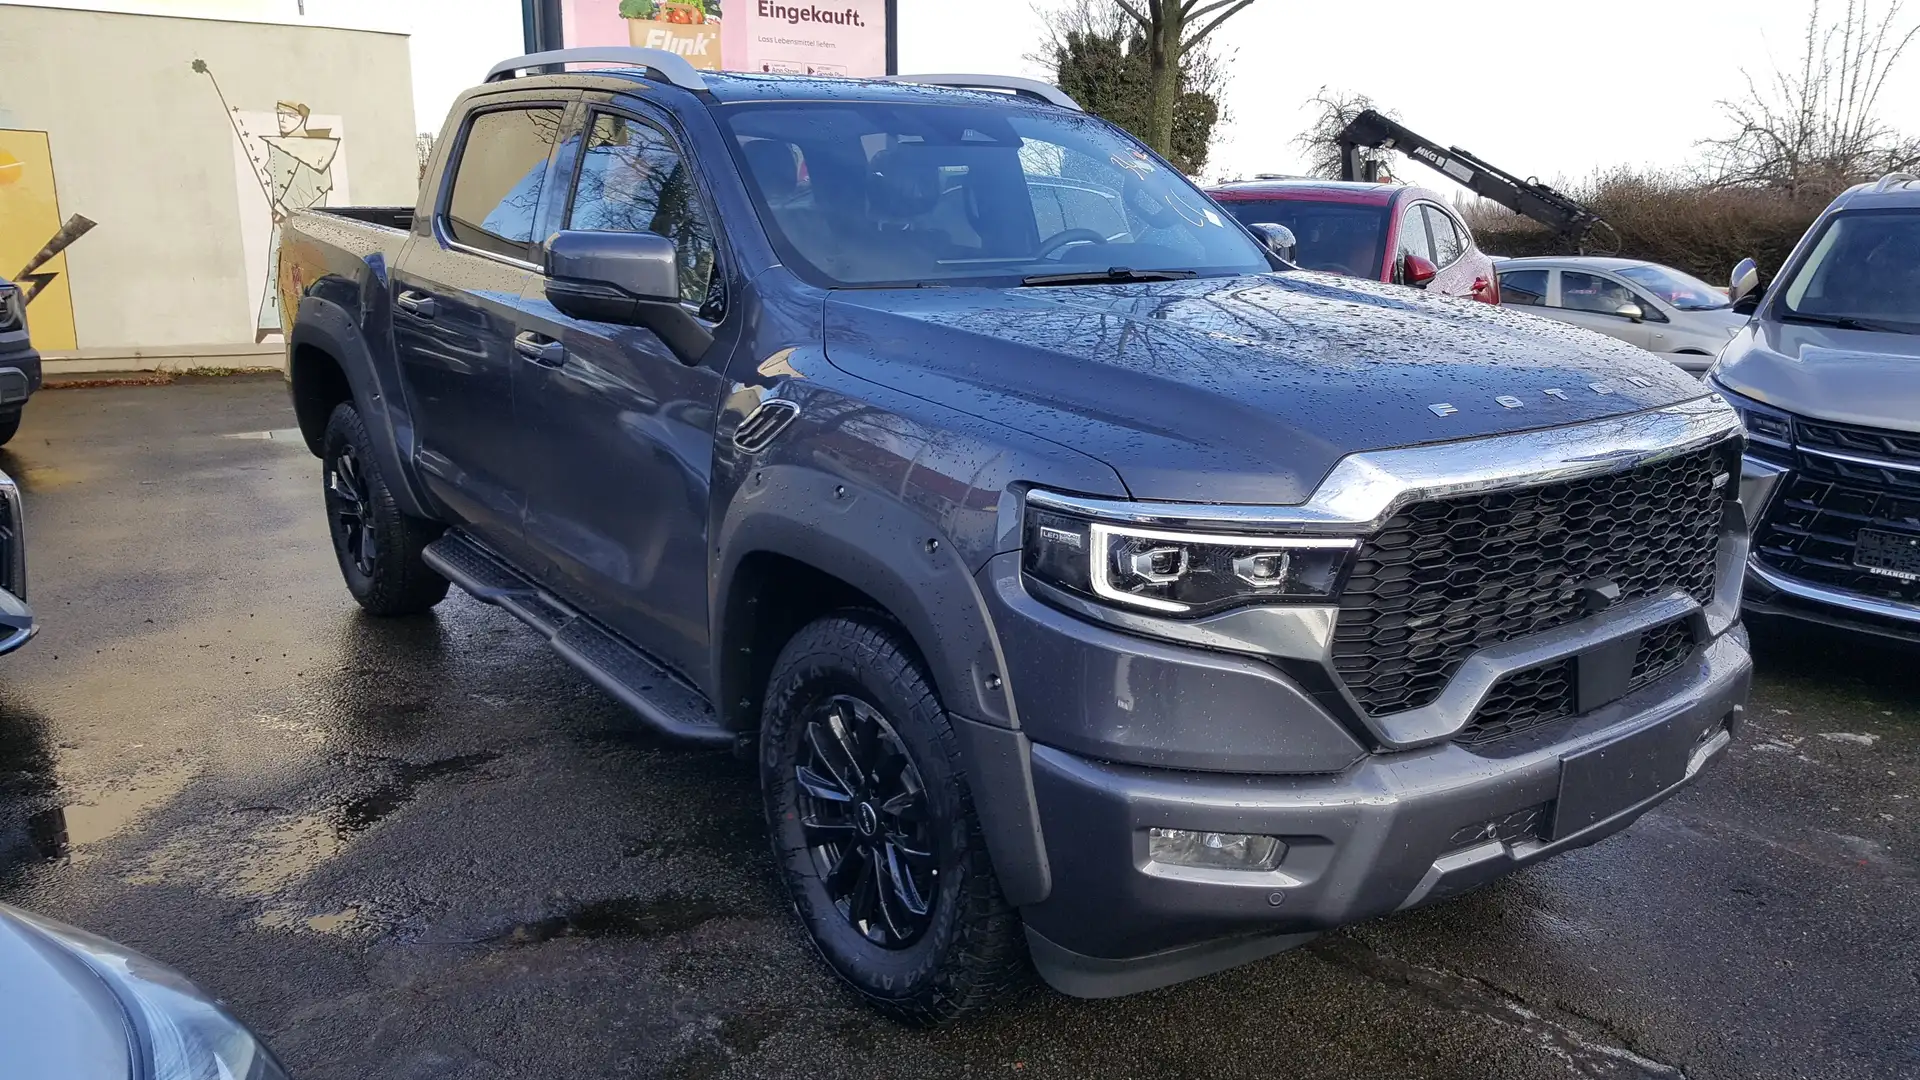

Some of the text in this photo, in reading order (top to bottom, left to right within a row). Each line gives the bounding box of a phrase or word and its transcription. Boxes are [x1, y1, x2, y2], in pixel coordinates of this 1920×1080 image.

[758, 0, 865, 27] Eingekauft.
[644, 29, 710, 56] Flink
[774, 36, 815, 47] Lebensmittel
[816, 39, 836, 49] liefern.
[1413, 146, 1438, 161] MKG
[1427, 376, 1652, 418] FOTON
[1870, 568, 1916, 580] SPRANGER
